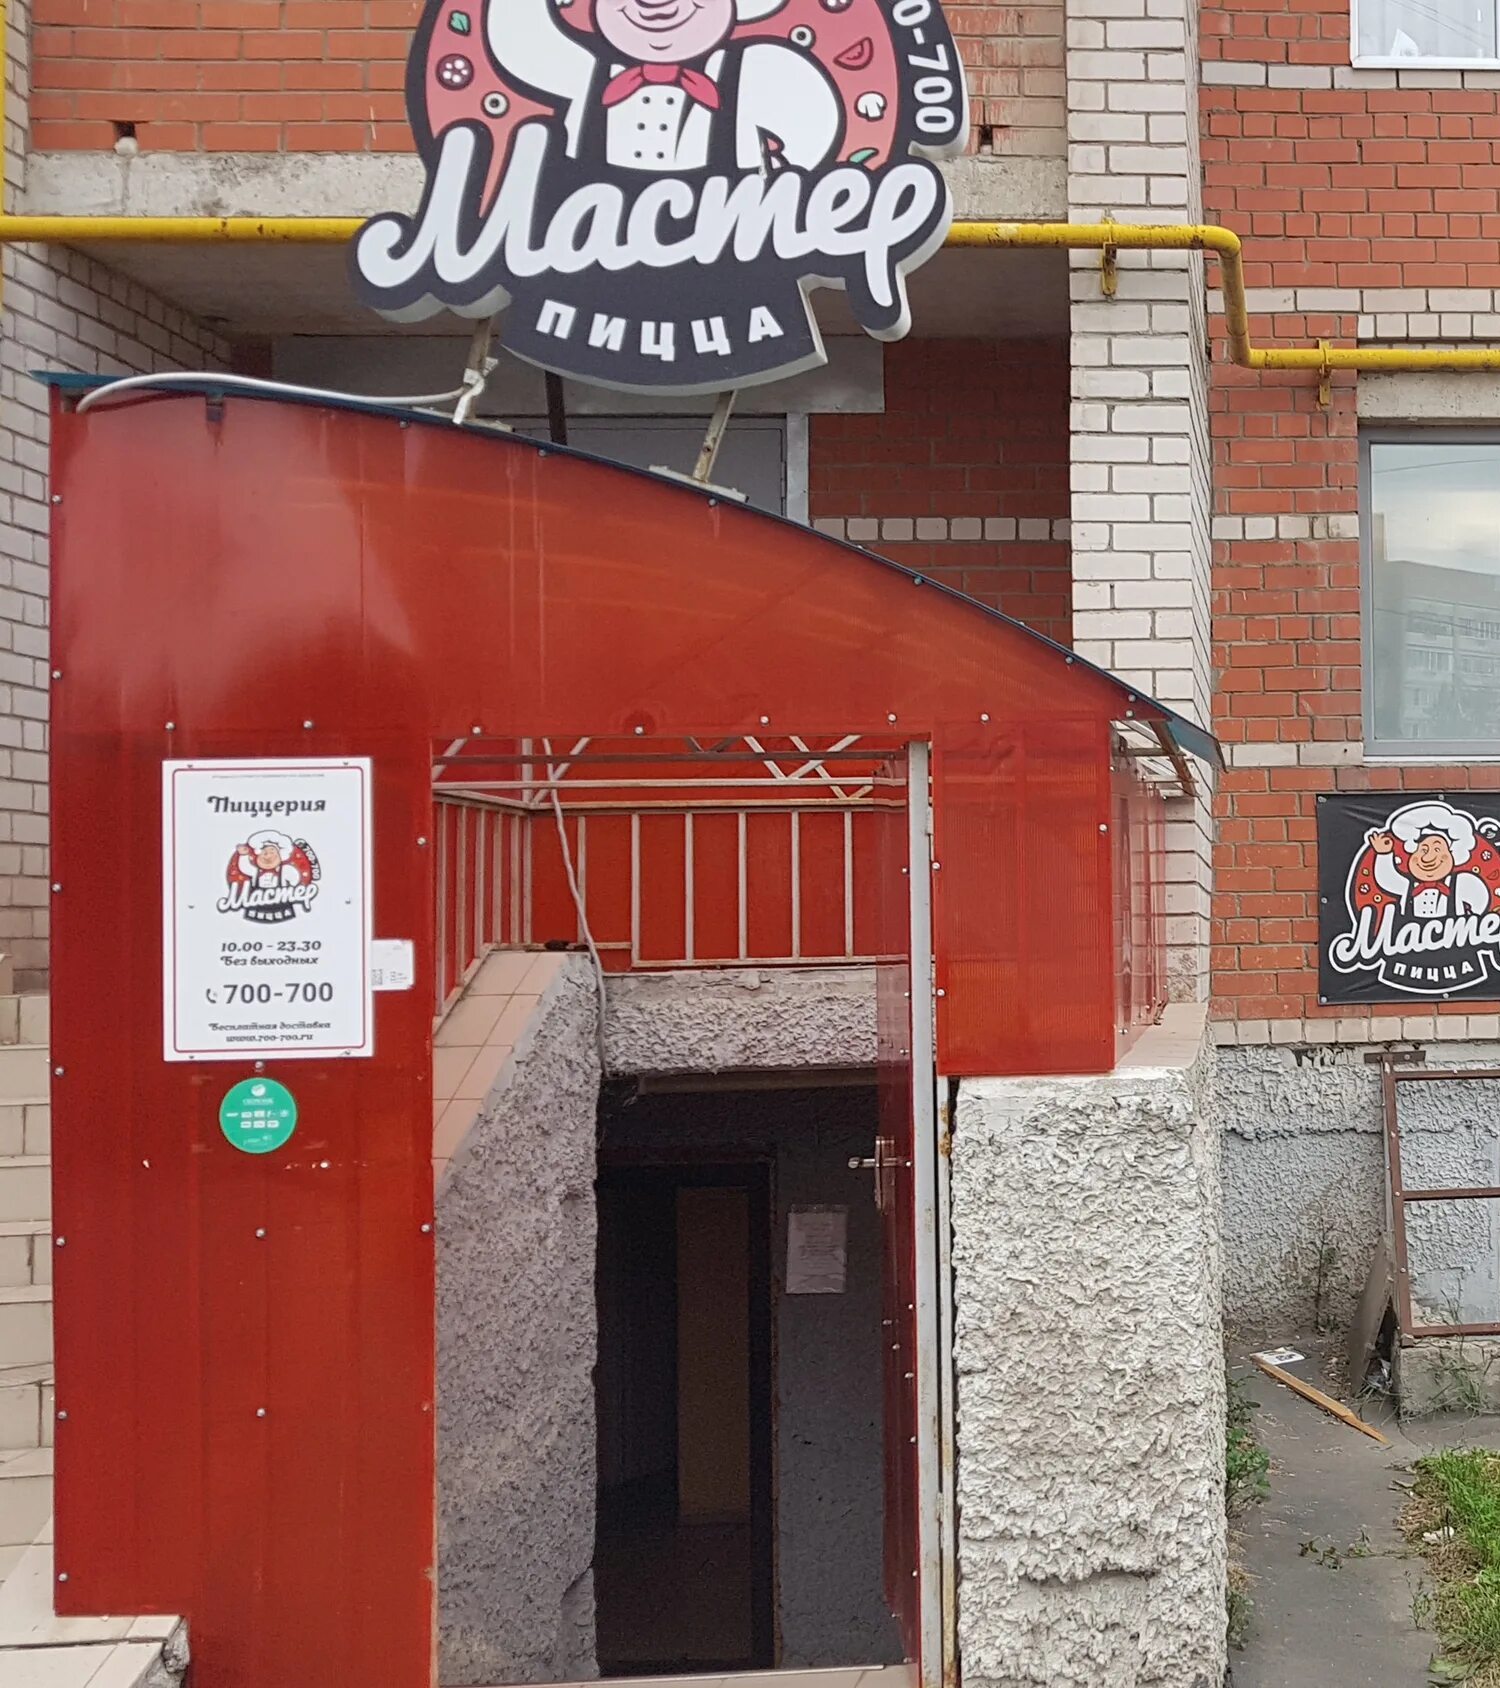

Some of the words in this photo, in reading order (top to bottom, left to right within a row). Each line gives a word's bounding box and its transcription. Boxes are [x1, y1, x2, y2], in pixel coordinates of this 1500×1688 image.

[357, 123, 937, 306] Мастер
[536, 300, 784, 361] ПИЦЦА
[207, 795, 326, 818] Пиццерия
[218, 880, 318, 911] Мастер
[221, 941, 263, 952] 10.00
[276, 940, 322, 952] 23.30
[220, 955, 247, 966] Без
[250, 954, 319, 966] выходных
[1393, 960, 1474, 982] ПИЦЦА
[223, 982, 333, 1004] 700-700
